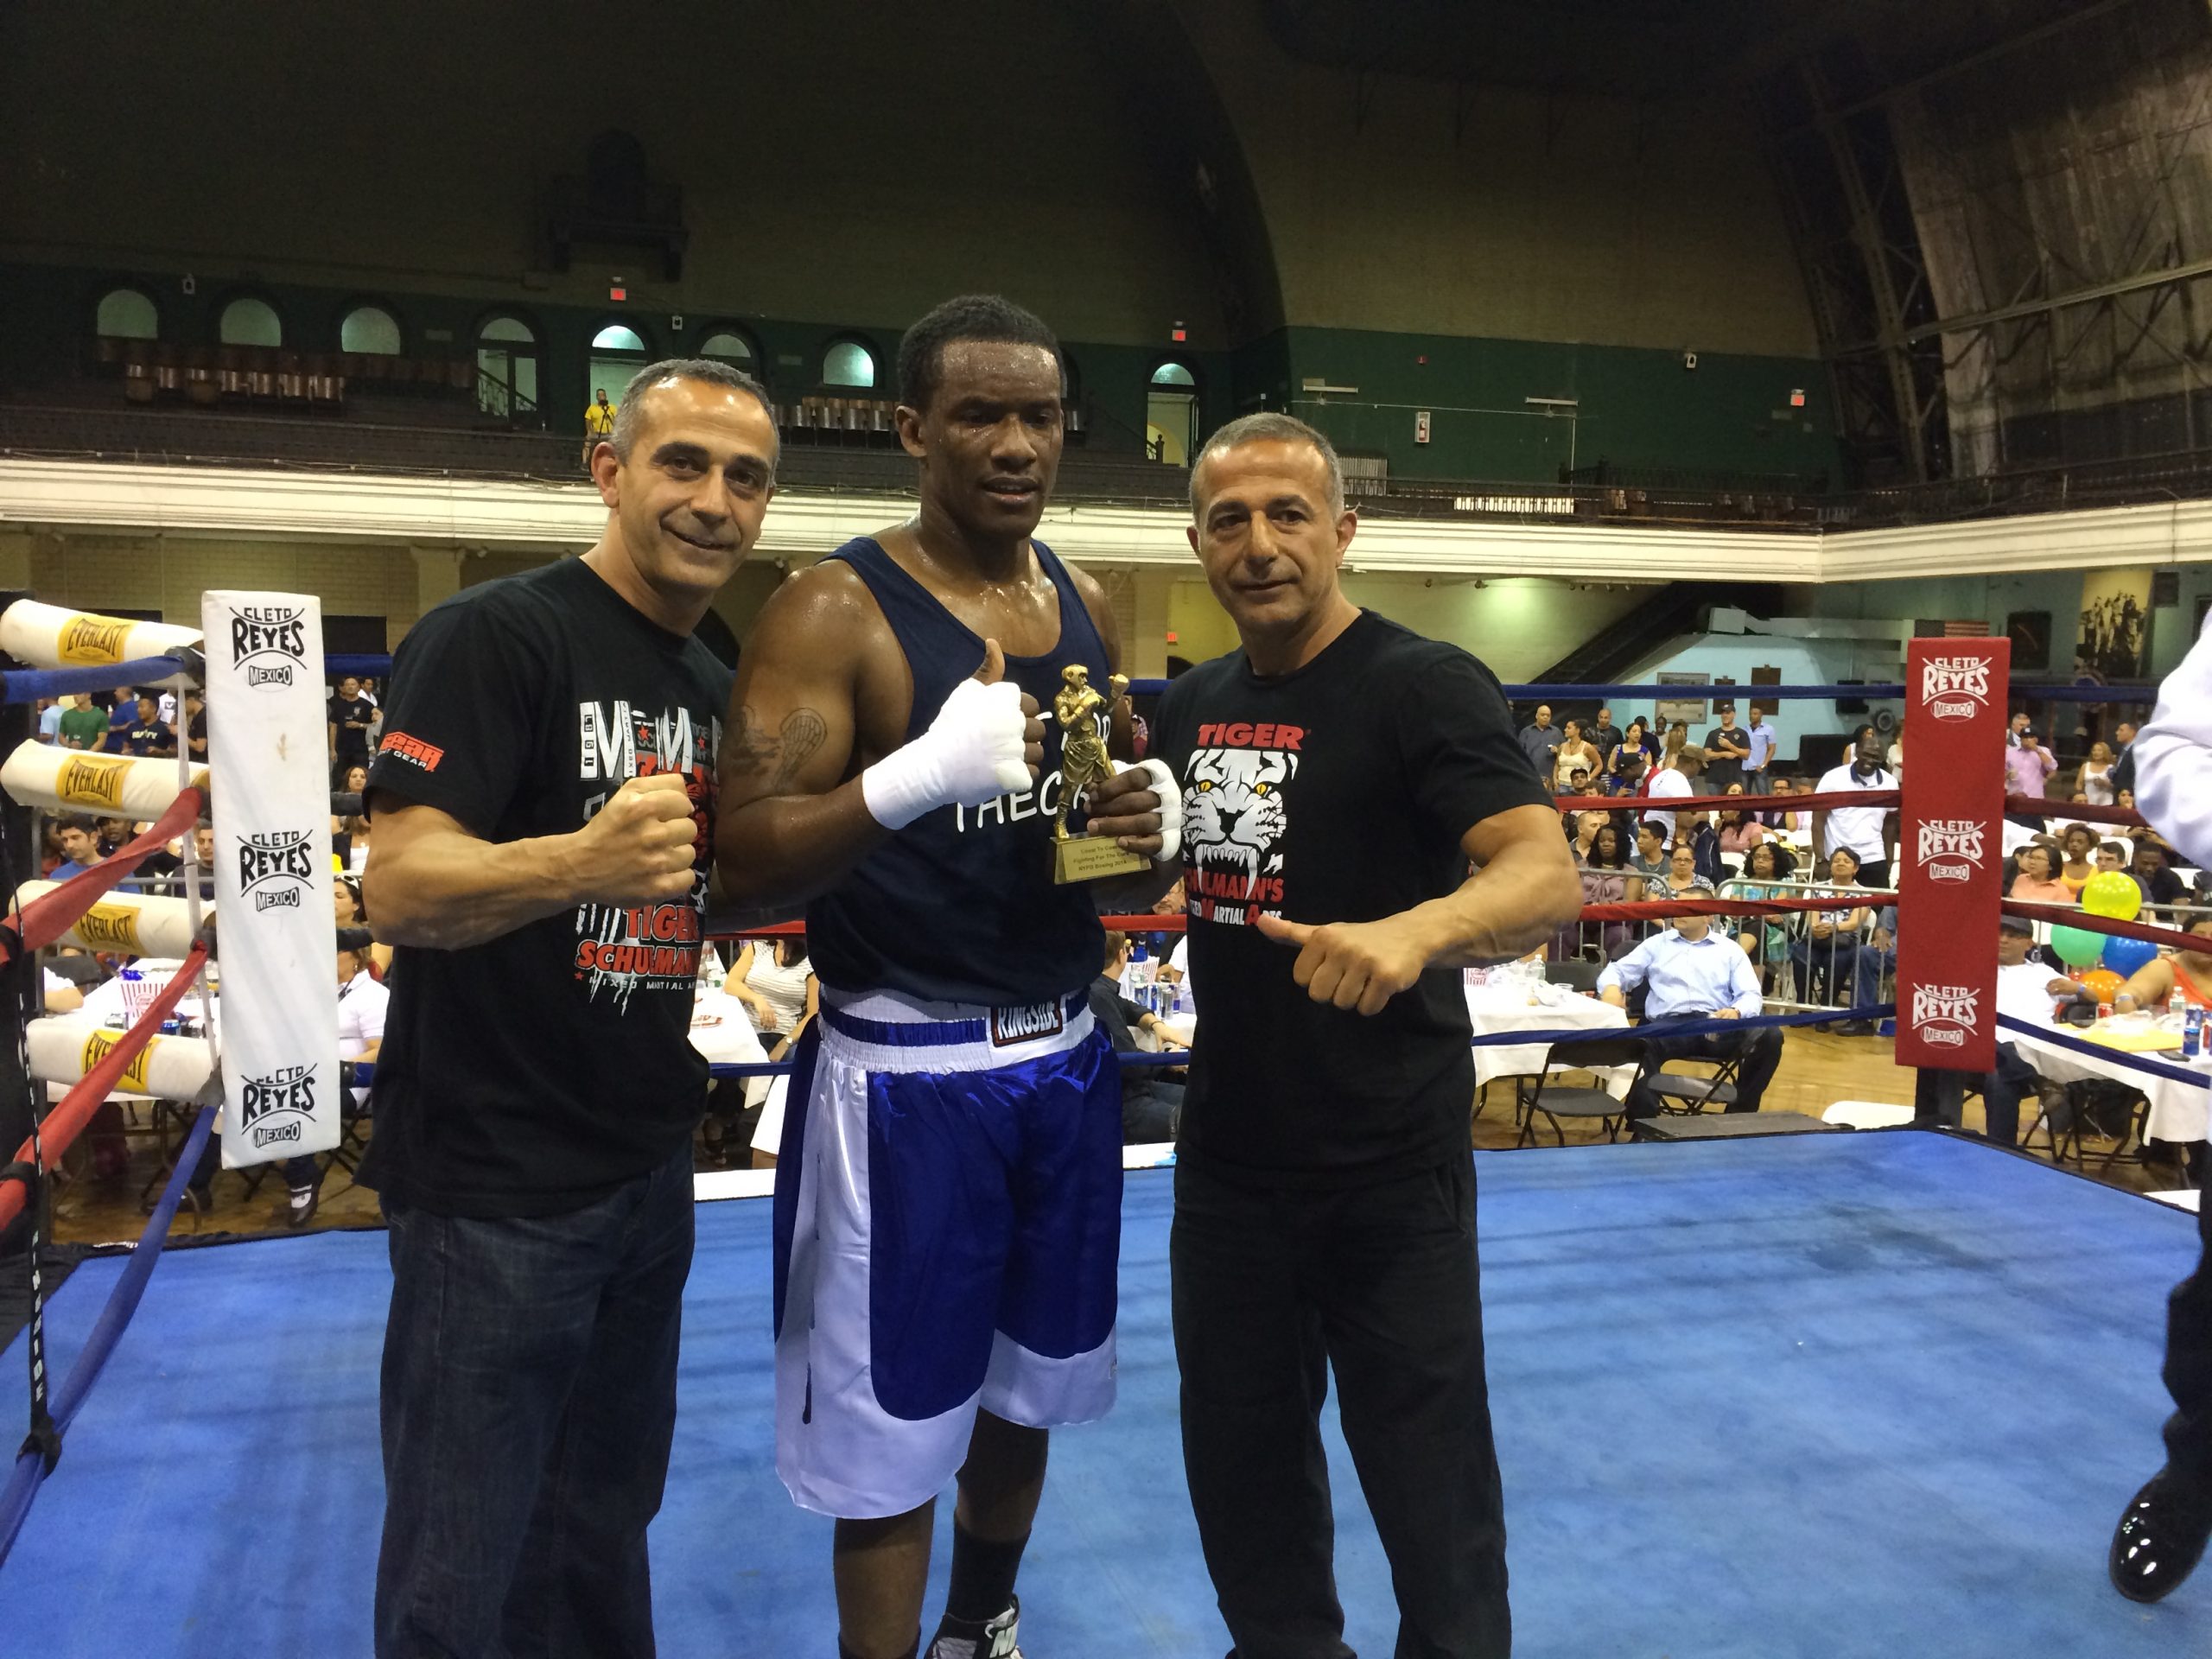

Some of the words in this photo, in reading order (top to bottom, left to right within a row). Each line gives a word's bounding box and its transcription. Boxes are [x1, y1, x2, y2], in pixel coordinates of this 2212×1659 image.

[244, 607, 291, 621] CLETO
[67, 618, 130, 657] EVERLAST
[232, 617, 305, 664] REYES
[1935, 657, 1980, 669] CLETO
[250, 666, 291, 686] MEXICO
[1923, 665, 1990, 702] REYES
[1936, 702, 1973, 716] MEXICO
[1198, 722, 1304, 751] TIGER
[393, 750, 427, 768] GEAR
[65, 760, 125, 802] EVERLAST
[251, 830, 300, 847] CLETO
[1929, 820, 1974, 832] CLETO
[1917, 827, 1985, 862] REYES
[239, 842, 312, 892] REYES
[1931, 865, 1968, 880] MEXICO
[257, 888, 299, 912] MEXICO
[1202, 898, 1245, 925] MARTIAL
[1925, 983, 1968, 998] CLETO
[1912, 990, 1978, 1026] REYES
[1925, 1027, 1962, 1044] MEXICO
[242, 1076, 315, 1129] REYES
[257, 1122, 300, 1148] MEXICO
